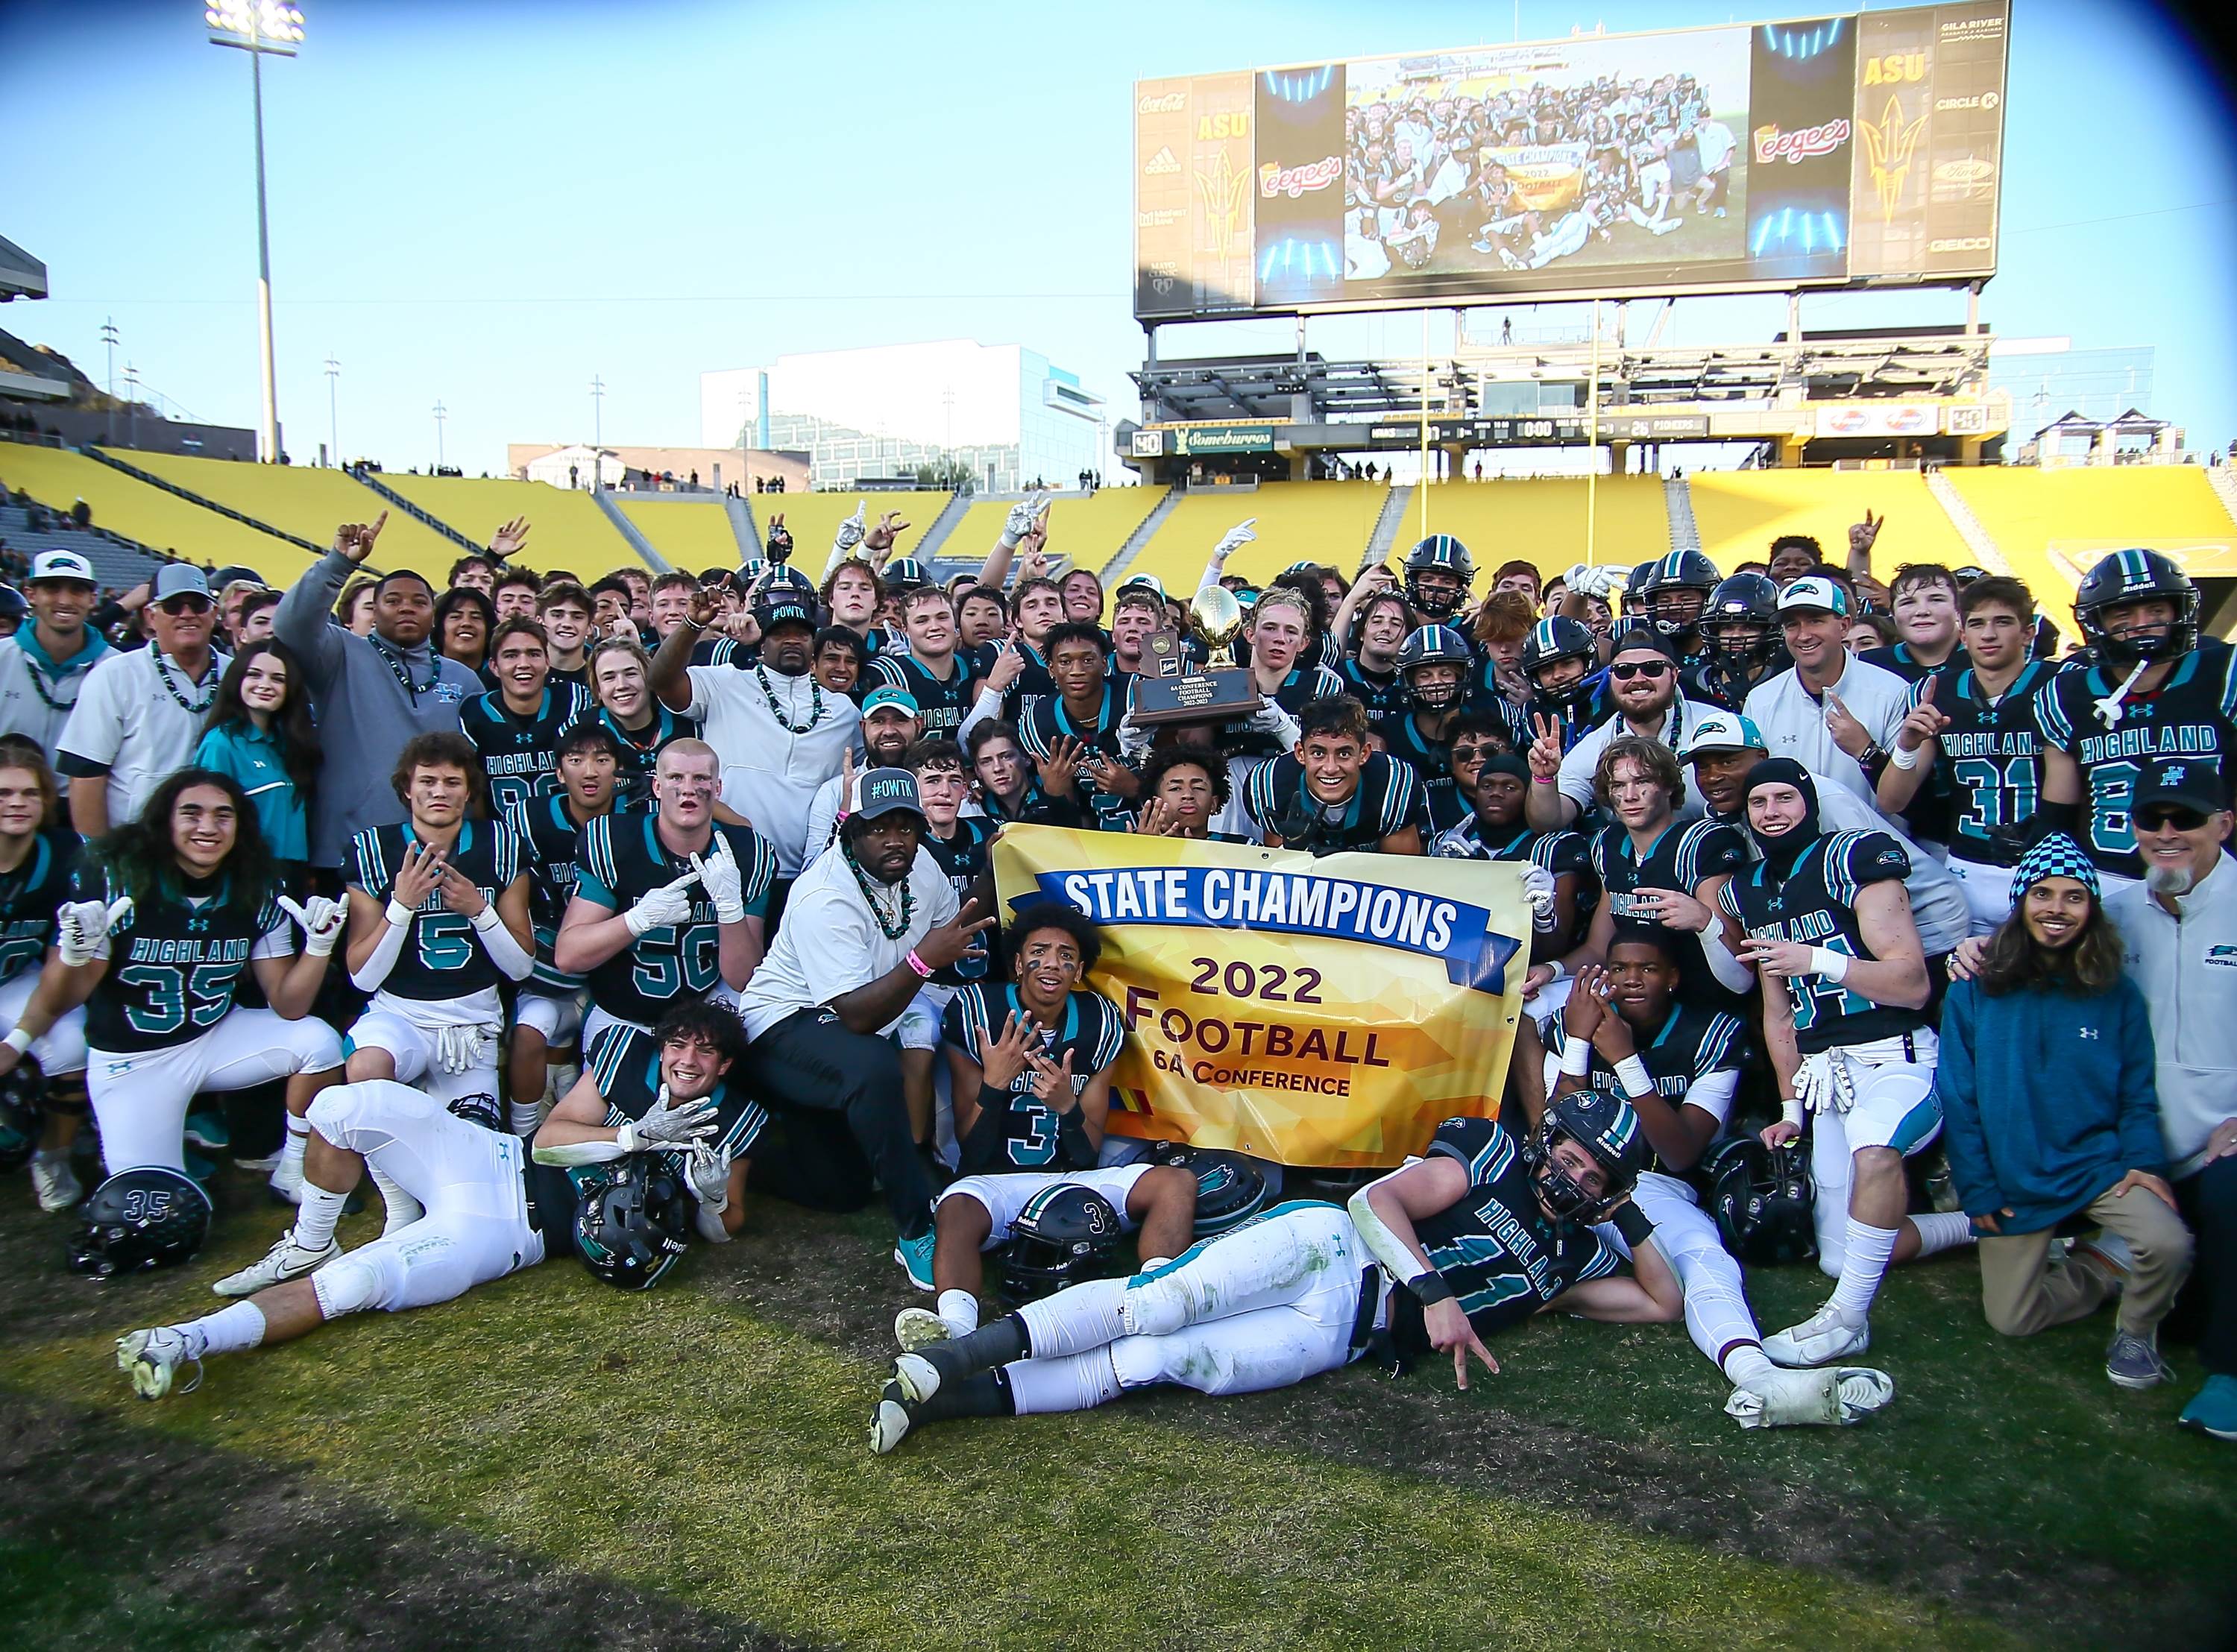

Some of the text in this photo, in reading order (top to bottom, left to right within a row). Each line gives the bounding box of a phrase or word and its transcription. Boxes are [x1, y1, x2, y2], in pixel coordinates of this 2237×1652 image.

[1940, 18, 2003, 31] GILA RIVER
[1863, 53, 1926, 86] ASU
[1936, 96, 1979, 110] CIRCLE
[1197, 112, 1249, 141] ASU
[1761, 119, 1850, 163] eegee's
[1265, 156, 1342, 197] eegee's
[1523, 169, 1550, 178] 2022
[1930, 237, 1991, 253] GEICO
[1524, 421, 1552, 438] 0:00
[1954, 410, 1982, 429] 40
[1136, 434, 1159, 453] 40
[1189, 430, 1271, 447] Someburros
[2123, 581, 2156, 593] Riddell
[772, 605, 805, 621] #OWTK
[1177, 693, 1213, 701] CHAMPIONS
[1178, 681, 1217, 690] CONFERENCE
[1179, 687, 1210, 696] FOOTBALL
[2080, 725, 2217, 764] HIGHLAND
[486, 751, 558, 775] HIGHLA
[872, 780, 913, 799] #OWTK
[1954, 756, 2037, 840] 31
[1064, 868, 1458, 952] STATE CHAMPIONS
[129, 938, 249, 963] HIGHLAND
[418, 912, 473, 970] 5
[1191, 958, 1322, 1004] 2022
[118, 962, 245, 1033] 35
[1127, 986, 1389, 1067] FOOTBALL
[1154, 1050, 1350, 1097] 6A CONFERENCE
[1007, 1094, 1060, 1165] 3
[1596, 1136, 1622, 1158] Riddell
[123, 1189, 170, 1223] 35
[1083, 1202, 1104, 1234] 3
[1474, 1197, 1561, 1300] HIGHLAND
[1420, 1234, 1532, 1316] 11
